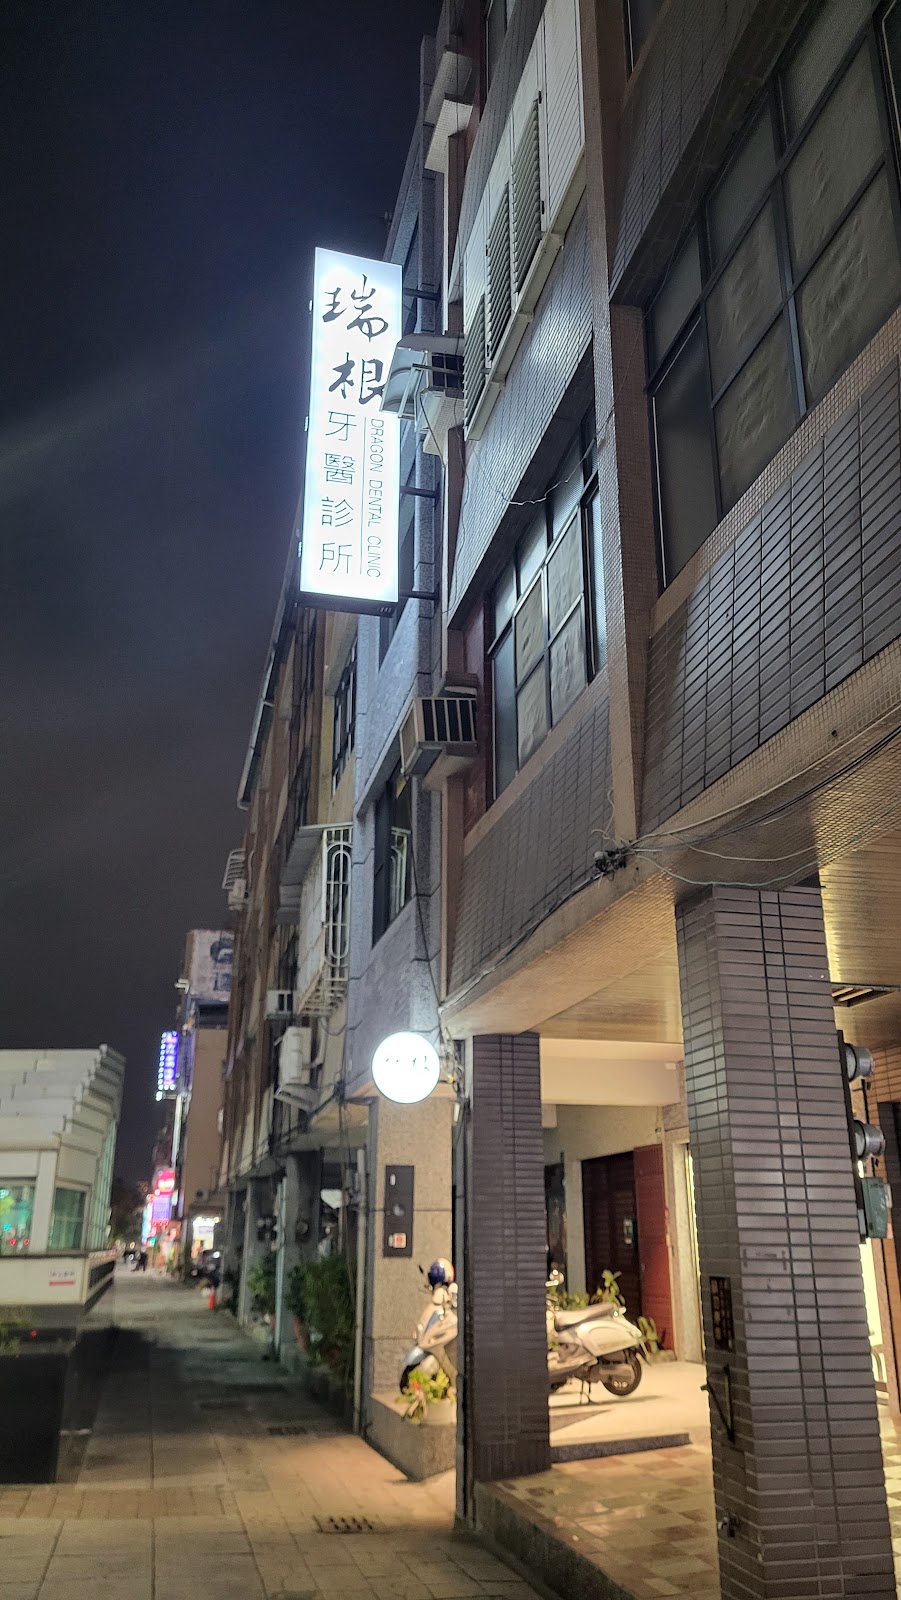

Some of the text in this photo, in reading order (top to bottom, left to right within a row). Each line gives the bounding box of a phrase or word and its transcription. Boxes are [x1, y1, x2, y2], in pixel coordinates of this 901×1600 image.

[322, 273, 389, 405] 瑞根
[319, 410, 357, 574] 牙醫診所
[366, 418, 385, 578] DRAGON DENTAL CLINIC
